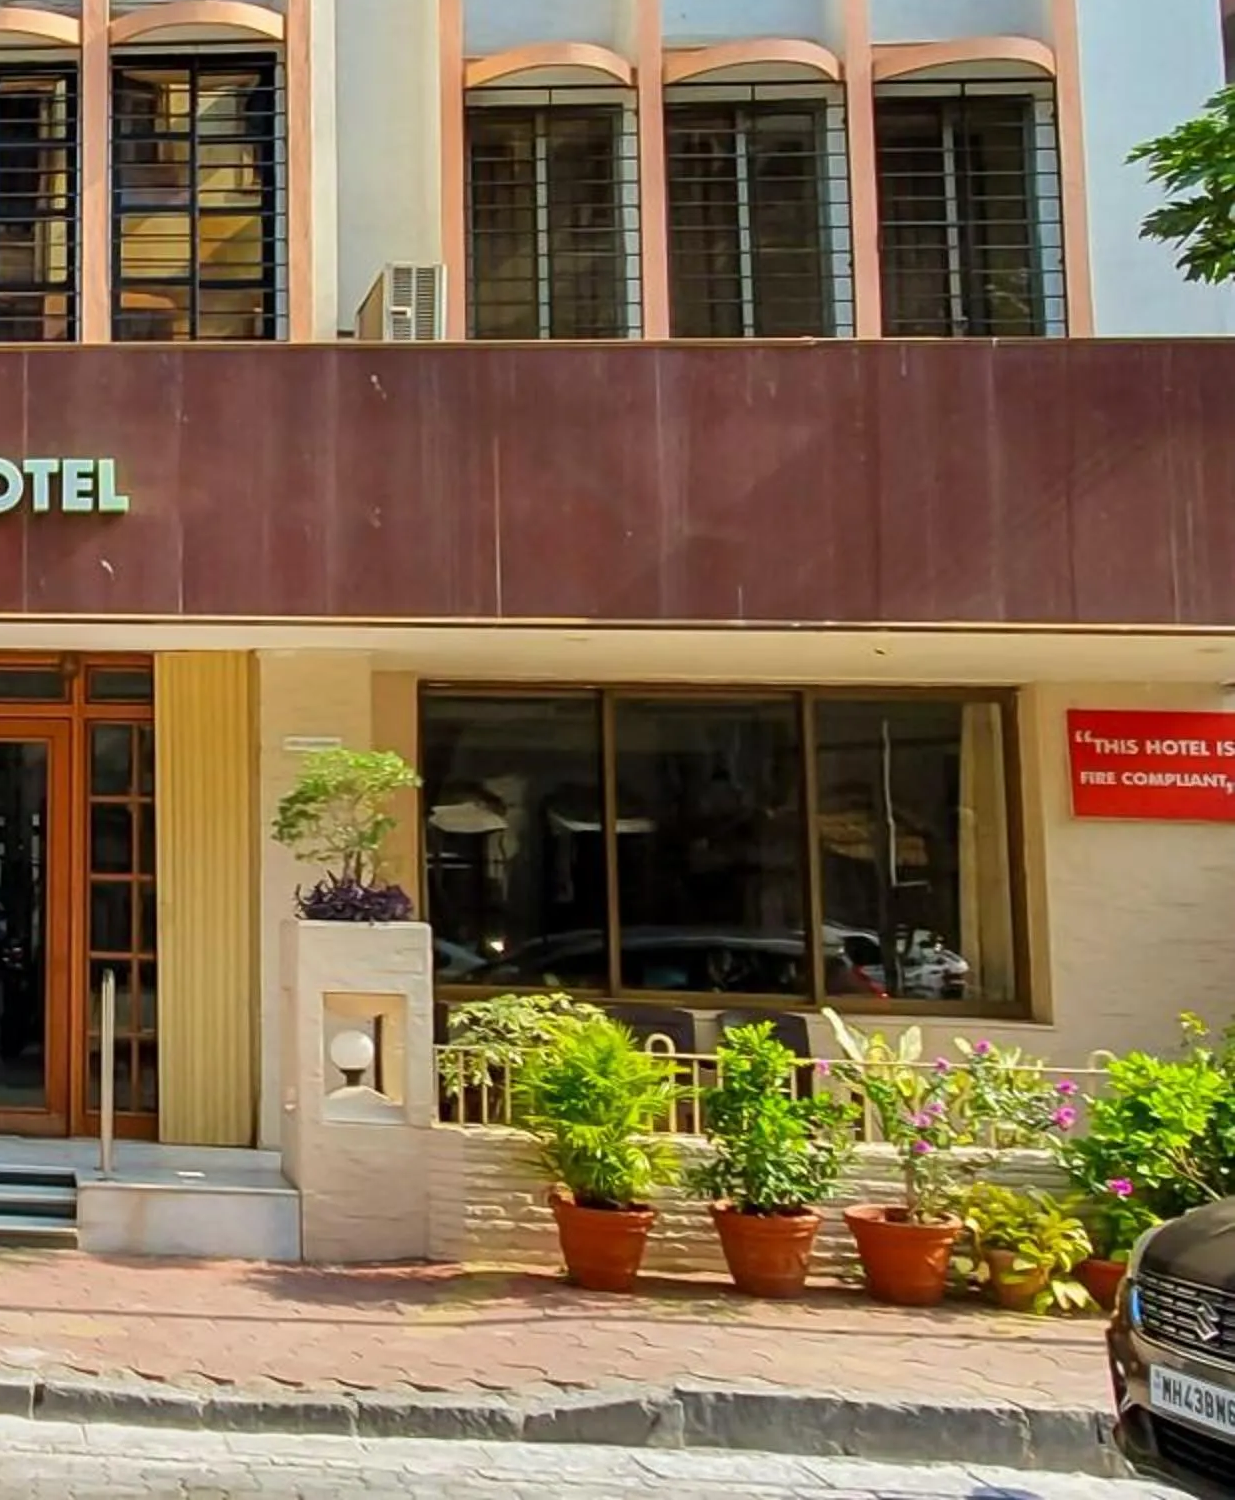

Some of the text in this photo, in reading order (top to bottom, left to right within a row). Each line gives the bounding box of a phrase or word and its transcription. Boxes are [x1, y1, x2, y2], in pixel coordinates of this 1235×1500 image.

[1145, 739, 1211, 757] HOTEL
[1216, 740, 1235, 757] IS
[1079, 771, 1117, 785] FIRE
